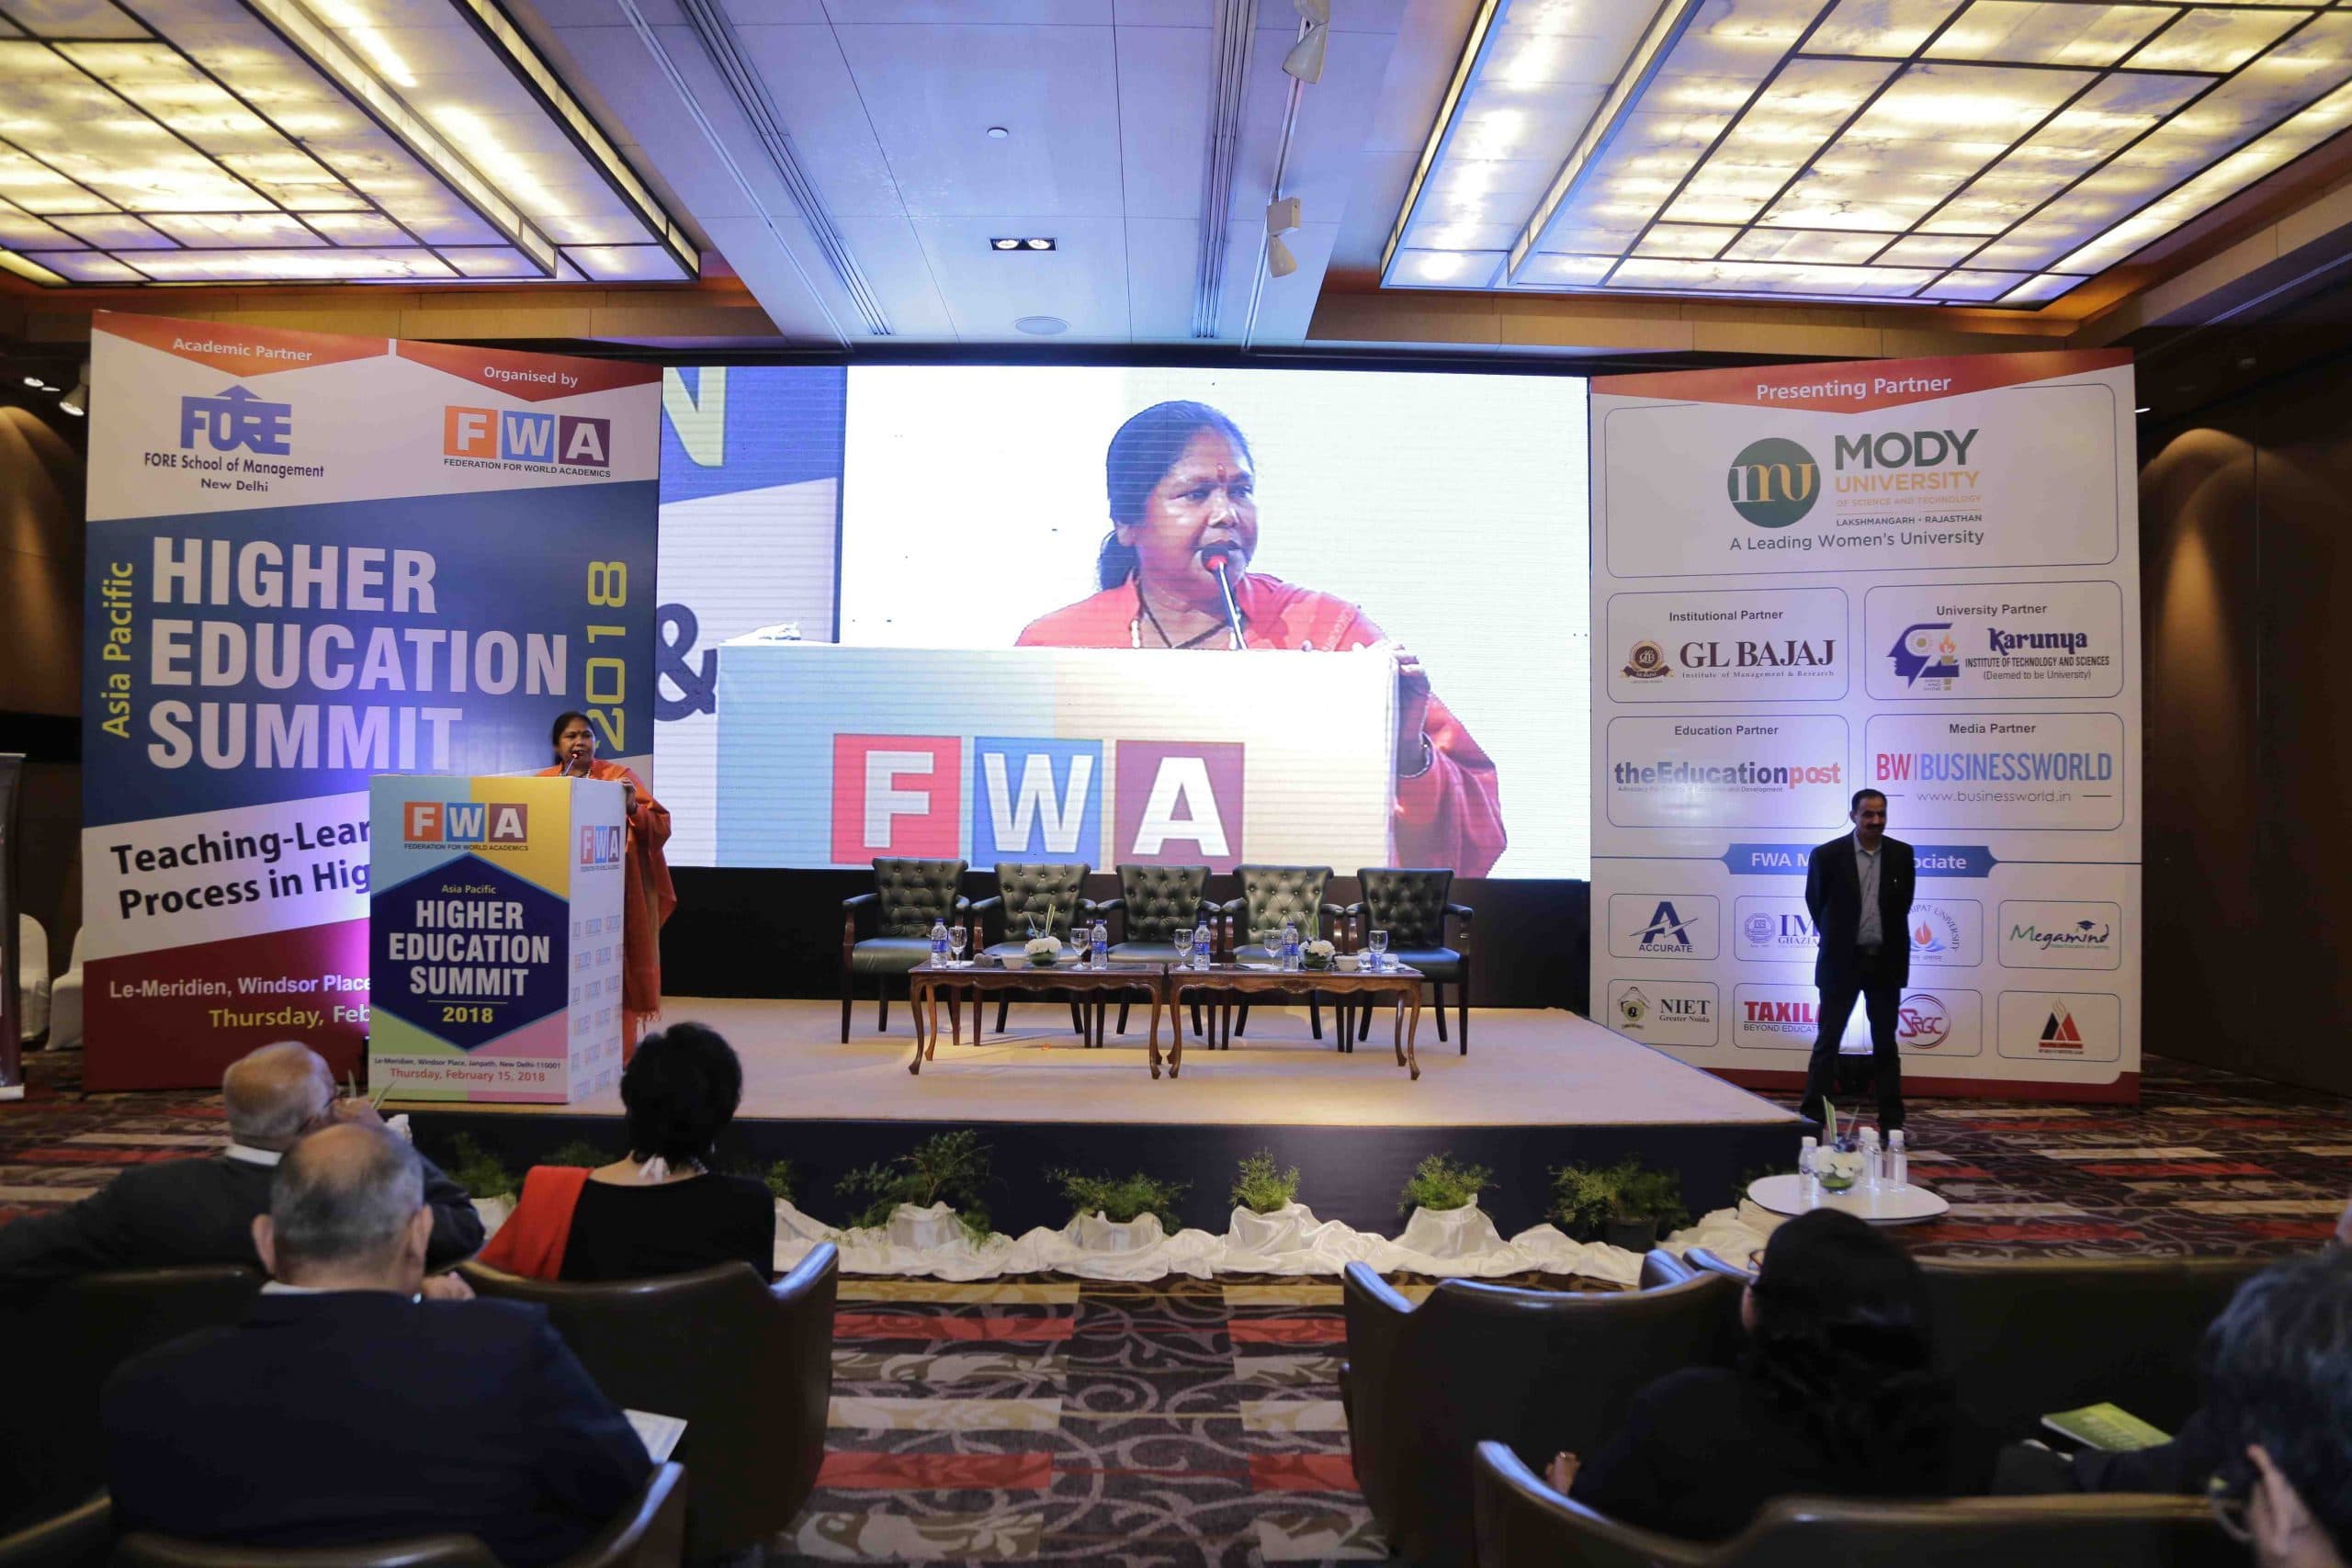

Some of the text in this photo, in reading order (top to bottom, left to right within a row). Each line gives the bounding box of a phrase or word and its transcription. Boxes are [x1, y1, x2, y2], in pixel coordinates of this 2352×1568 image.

[172, 337, 313, 361] Academic Partner
[484, 367, 578, 388] Organised by
[1757, 377, 1952, 400] Presenting Partner
[180, 395, 293, 456] FORE
[457, 412, 605, 462] FWA
[1834, 428, 1980, 470] MODY
[145, 452, 324, 479] FORE School of Management
[444, 458, 611, 478] FEDERATION FOR WORLD ACADEMICS
[200, 479, 269, 492] New Delhi
[1835, 470, 1981, 493] UNIVERSITY
[1852, 497, 1891, 507] SCIENCE
[1837, 513, 1983, 526] LAKSHMANGARH RAJASTHAN
[1729, 529, 1984, 552] A Leading Women's University
[153, 536, 437, 614] HIGHER
[1669, 610, 1783, 622] Institutional Partner
[1936, 604, 2048, 616] University Partner
[101, 560, 134, 740] Asia Pacific
[1987, 627, 2087, 656] Karunya
[151, 618, 568, 696] EDUCATION
[586, 560, 628, 751] 2018
[1679, 641, 1731, 669] GL
[1736, 639, 1837, 668] BAJAJ
[1965, 656, 2109, 668] INSTITUTE OF TECHNOLOGY AND SCIENCES
[1682, 671, 1717, 679] Institute
[1733, 671, 1784, 680] Management
[1797, 670, 1835, 678] Research
[1984, 670, 2092, 681] (Deemed to be University)
[147, 700, 463, 770] SUMMIT
[1674, 725, 1780, 736] Education Partner
[1949, 723, 2037, 734] Media Partner
[1614, 761, 1841, 790] theEducationpost
[1877, 752, 2112, 782] BW BUSINESSWORLD
[863, 750, 1231, 858] FWA
[1917, 790, 2072, 803] www.businessworld.in
[413, 807, 525, 839] FWA
[582, 828, 620, 863] FWA
[1751, 852, 1791, 867] FWA
[119, 879, 260, 919] Process
[268, 868, 303, 898] in
[441, 884, 496, 895] Asia Pacific
[416, 899, 524, 930] HIGHER
[390, 932, 549, 964] EDUCATION
[1639, 943, 1693, 953] ACCURATE
[2009, 923, 2109, 950] Megamind
[109, 977, 232, 998] Le-Meridien,
[237, 976, 318, 994] Windsor
[410, 965, 529, 996] SUMMIT
[209, 1006, 325, 1029] Thursday,
[442, 1006, 493, 1023] 2018
[1660, 998, 1711, 1015] NIET
[1659, 1014, 1711, 1023] Greater Noida
[1744, 1023, 1780, 1032] BEYOND
[390, 1068, 546, 1082] Thursday, February 15, 2018
